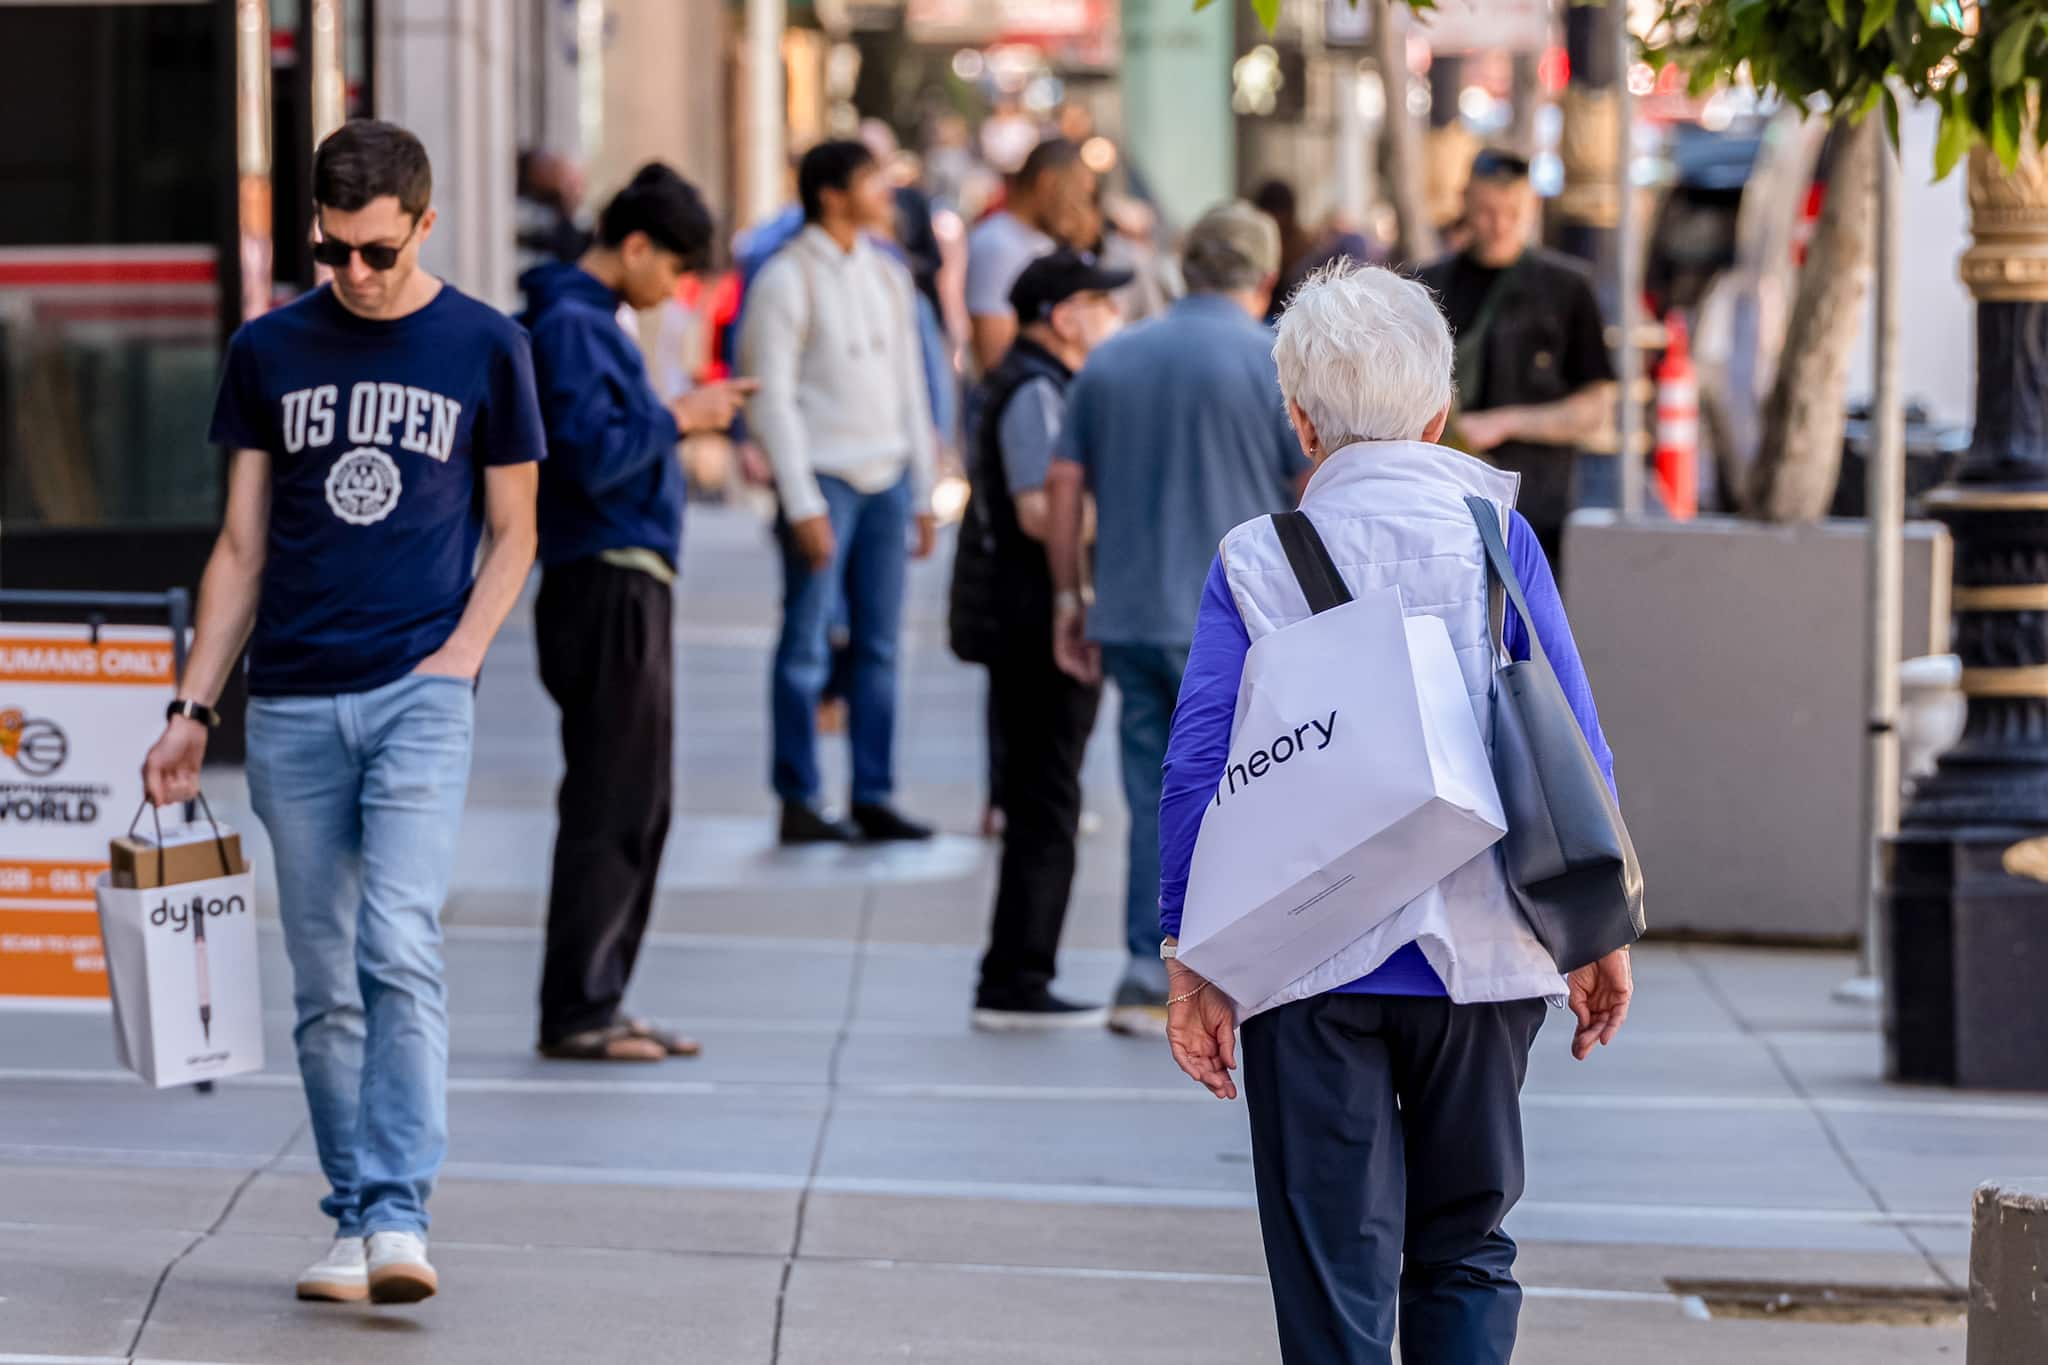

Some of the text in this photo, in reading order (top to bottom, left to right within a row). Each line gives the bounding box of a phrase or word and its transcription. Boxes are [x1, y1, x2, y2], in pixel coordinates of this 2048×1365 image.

[281, 381, 462, 463] US OPEN
[0, 648, 175, 677] UMANS ONLY
